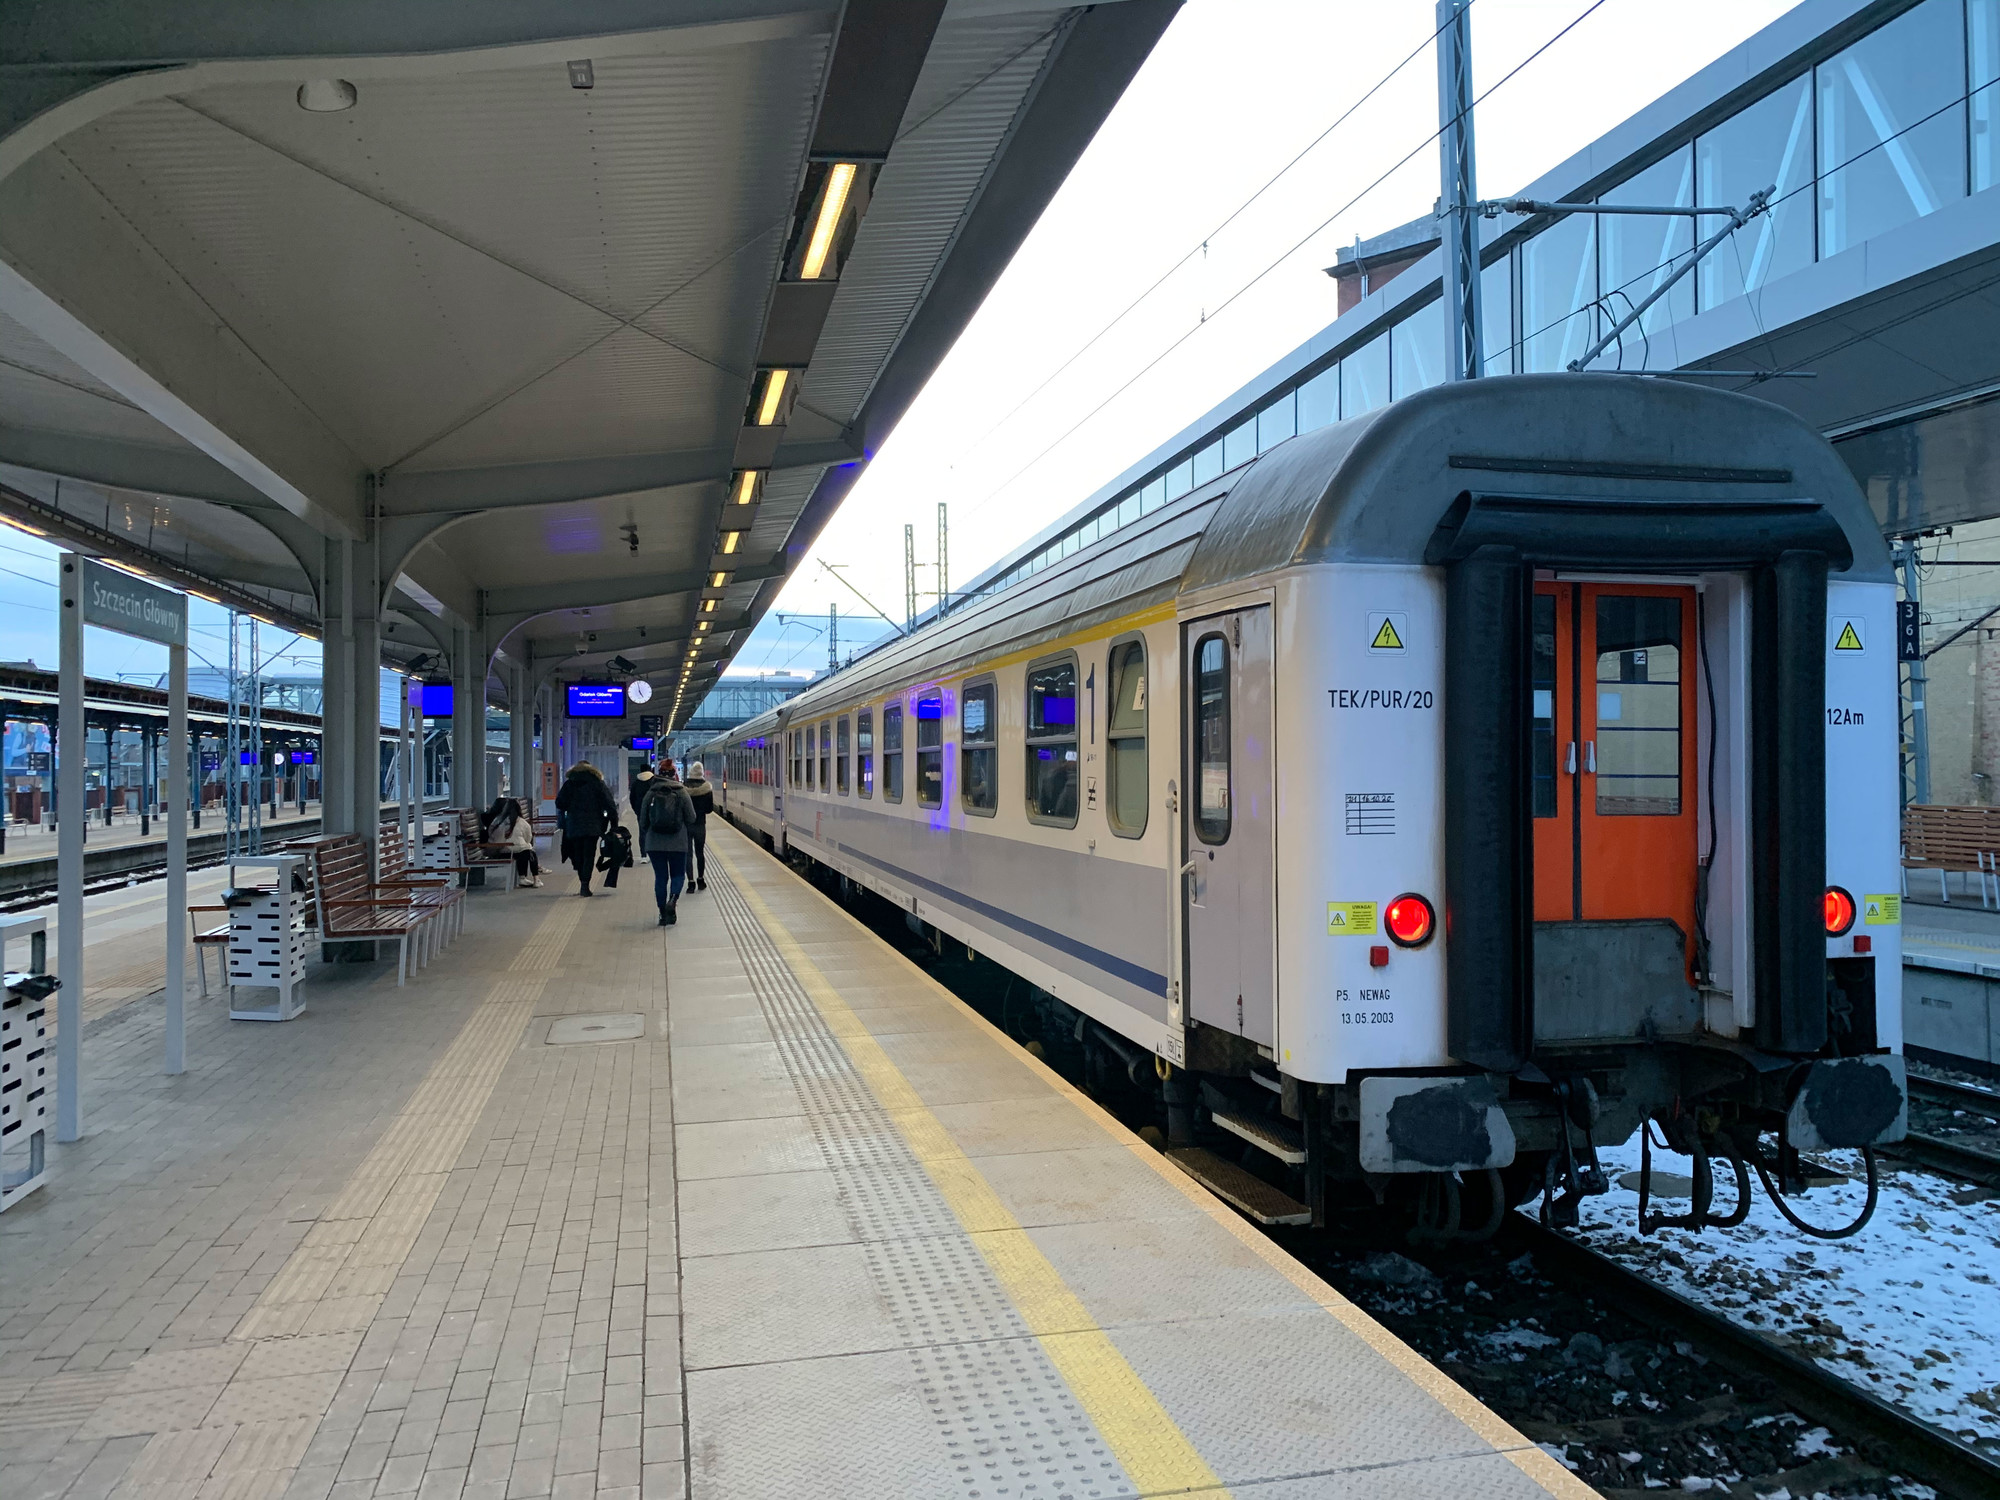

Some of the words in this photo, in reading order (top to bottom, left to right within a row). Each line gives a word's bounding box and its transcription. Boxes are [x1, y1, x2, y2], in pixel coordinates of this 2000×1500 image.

[93, 580, 141, 619] Szczecin
[143, 598, 180, 635] Główny
[1905, 604, 1914, 618] 3
[1905, 624, 1914, 636] 6
[1905, 642, 1915, 654] A
[1086, 662, 1095, 745] 1
[1328, 690, 1433, 708] TEK/PUR/20
[1360, 989, 1391, 1001] NEWAG
[1342, 1012, 1394, 1024] 13.05.2003
